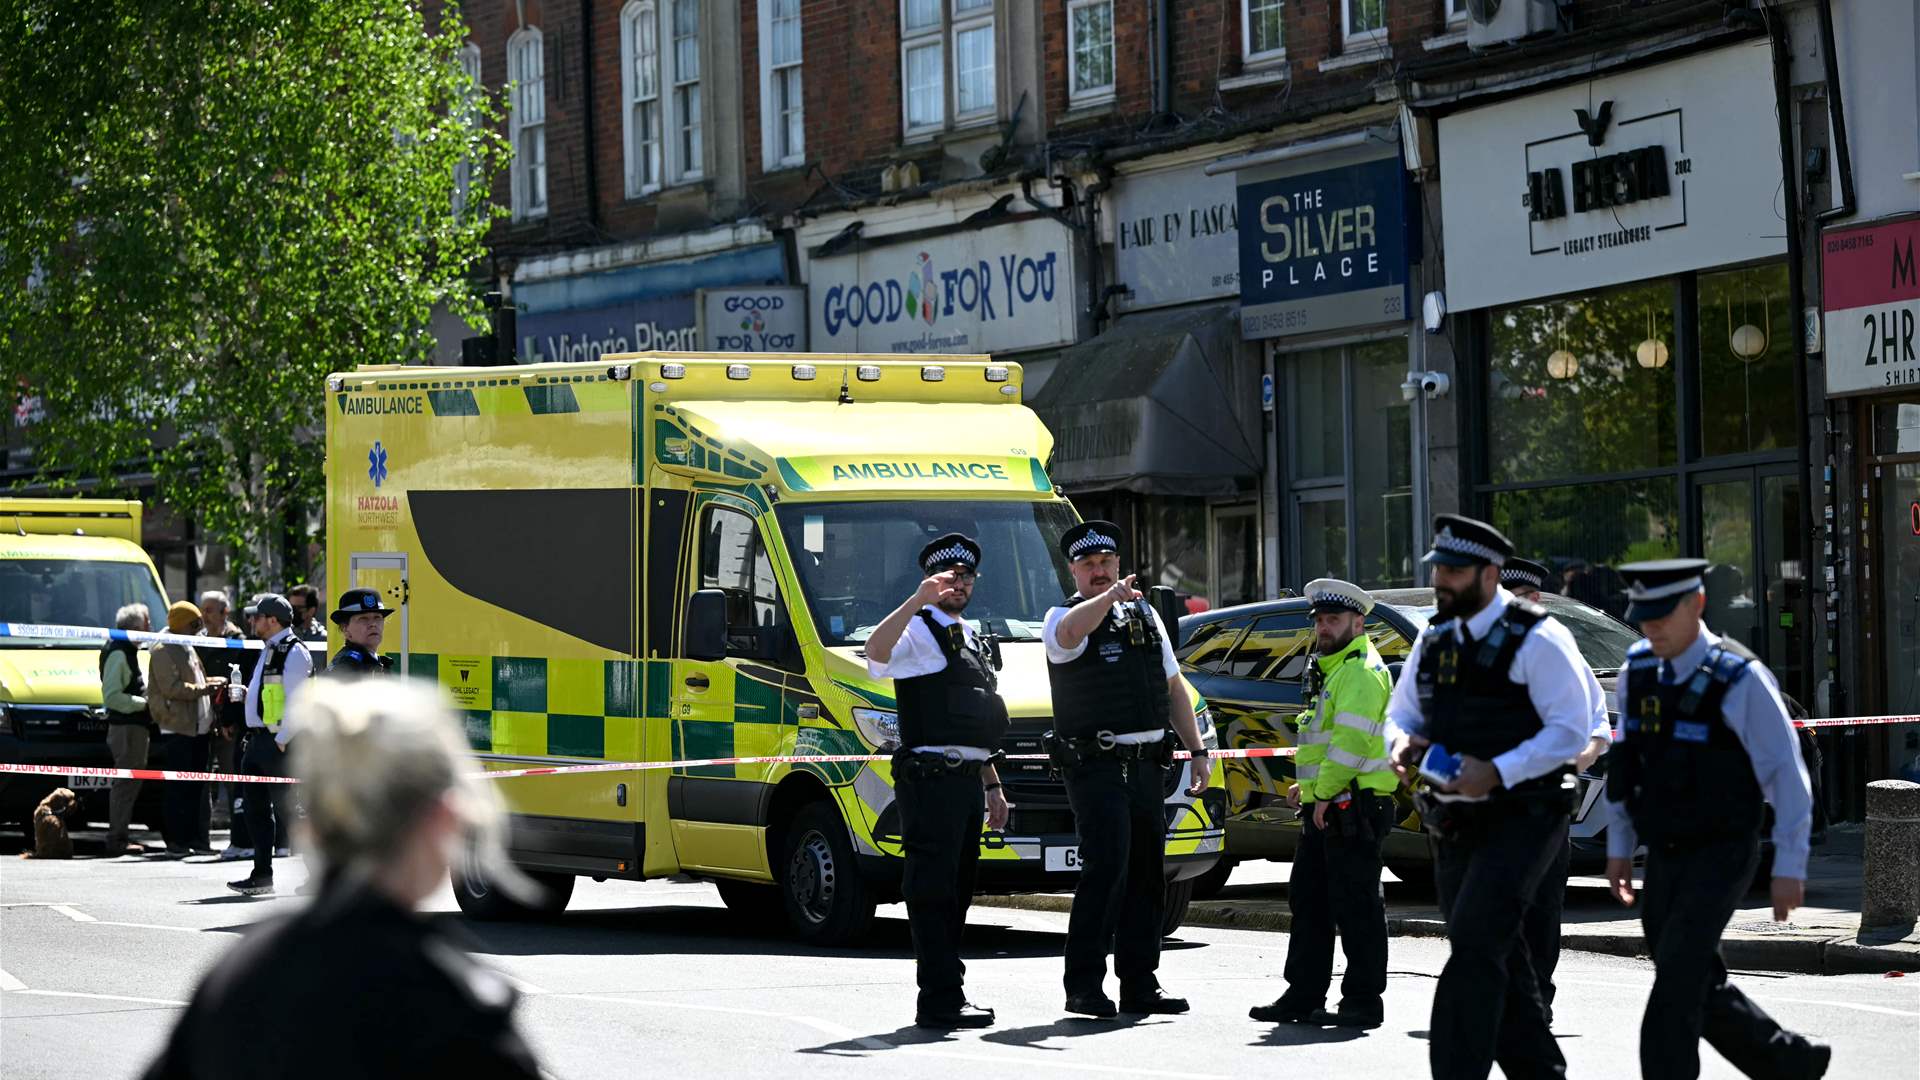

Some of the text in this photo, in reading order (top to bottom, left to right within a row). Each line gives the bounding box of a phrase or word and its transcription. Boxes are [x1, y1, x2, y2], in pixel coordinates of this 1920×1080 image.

[1294, 189, 1322, 211] THE
[1120, 217, 1155, 250] HAIR
[1164, 211, 1182, 243] BY
[1260, 195, 1376, 263] SILVER
[1563, 225, 1651, 256] LEGACY STEAKHOUSE
[1262, 253, 1379, 289] PLACE
[724, 296, 785, 313] GOOD
[824, 251, 1056, 337] GOOD FOR YOU
[549, 328, 629, 361] Victoria
[716, 332, 796, 350] FOR YOU
[1863, 308, 1916, 367] 2HR
[347, 396, 423, 415] AMBULANCE
[833, 462, 1009, 481] AMBULANCE
[358, 496, 399, 511] HATZOLA
[358, 511, 398, 524] NORTHWEST
